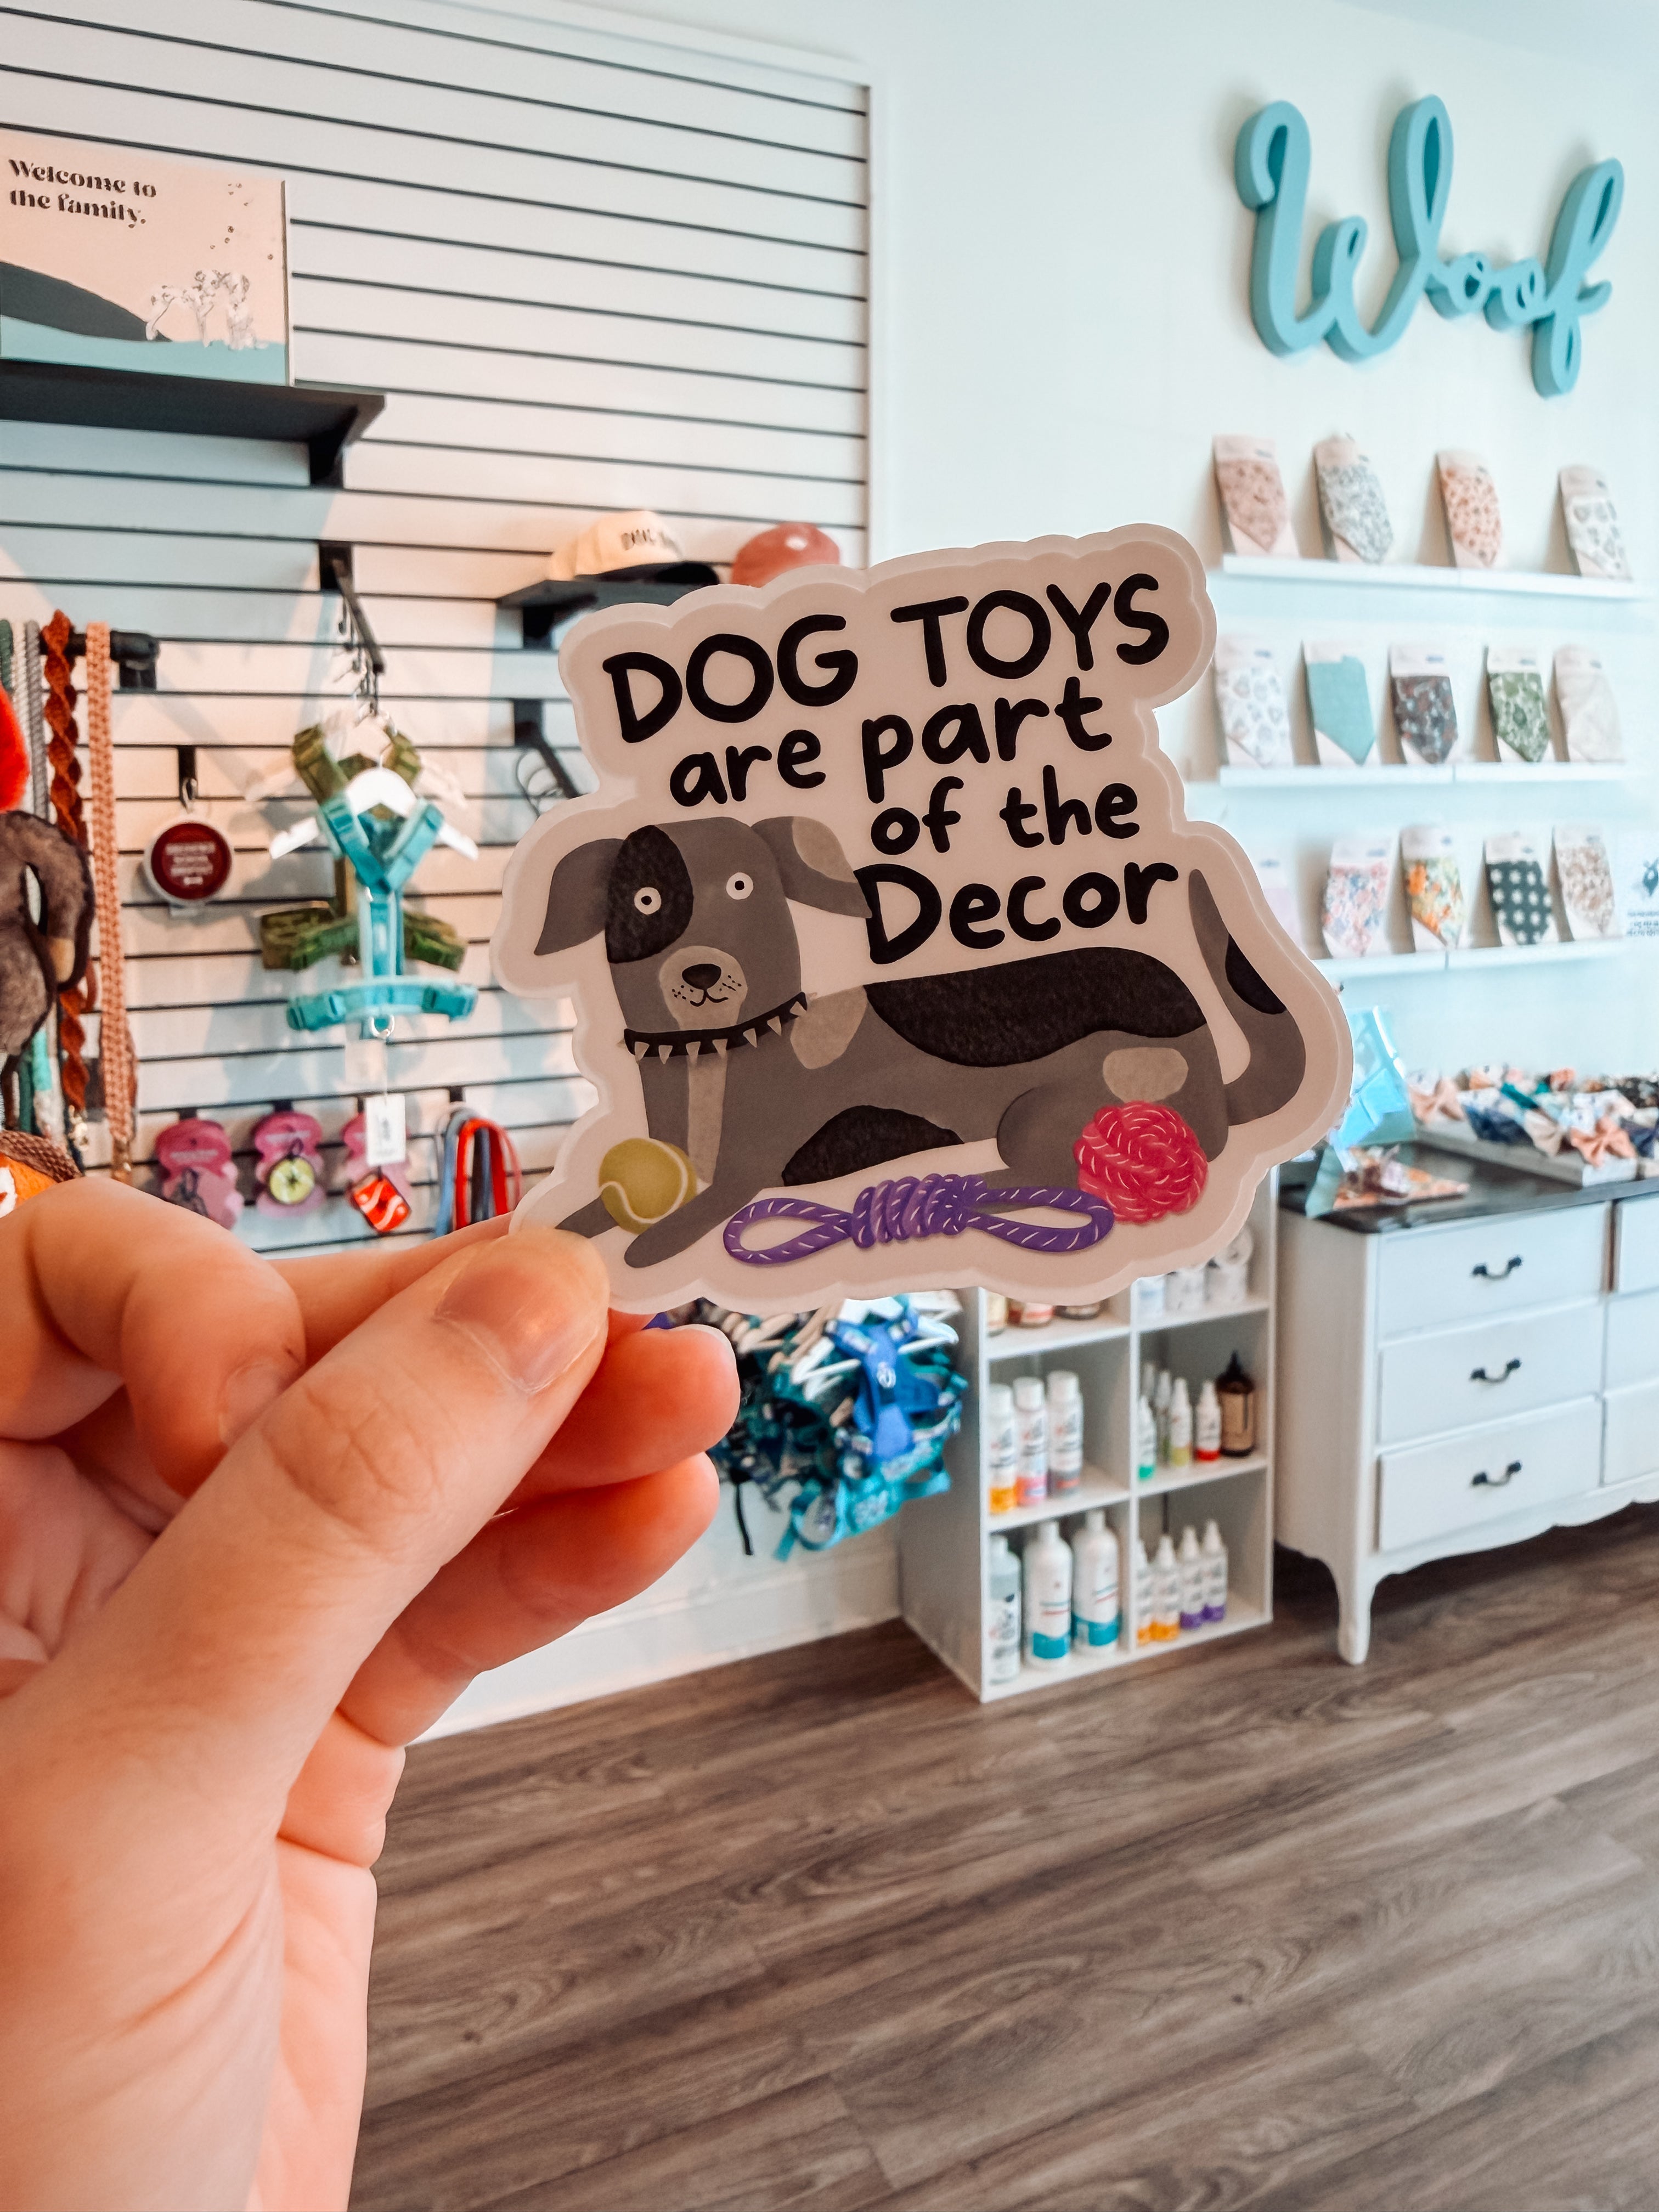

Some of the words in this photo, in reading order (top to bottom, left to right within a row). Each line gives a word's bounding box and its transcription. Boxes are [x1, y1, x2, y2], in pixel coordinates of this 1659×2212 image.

[8, 159, 126, 193] Welcome
[133, 180, 157, 198] to
[10, 190, 51, 209] the
[57, 193, 146, 229] family.
[1234, 94, 1624, 399] Woof
[603, 615, 857, 743] DOG
[890, 574, 1169, 687] TOYS
[670, 730, 826, 806] are
[862, 677, 1111, 804] part
[871, 776, 964, 855] of
[1000, 765, 1139, 848] the
[853, 862, 1178, 964] Decor
